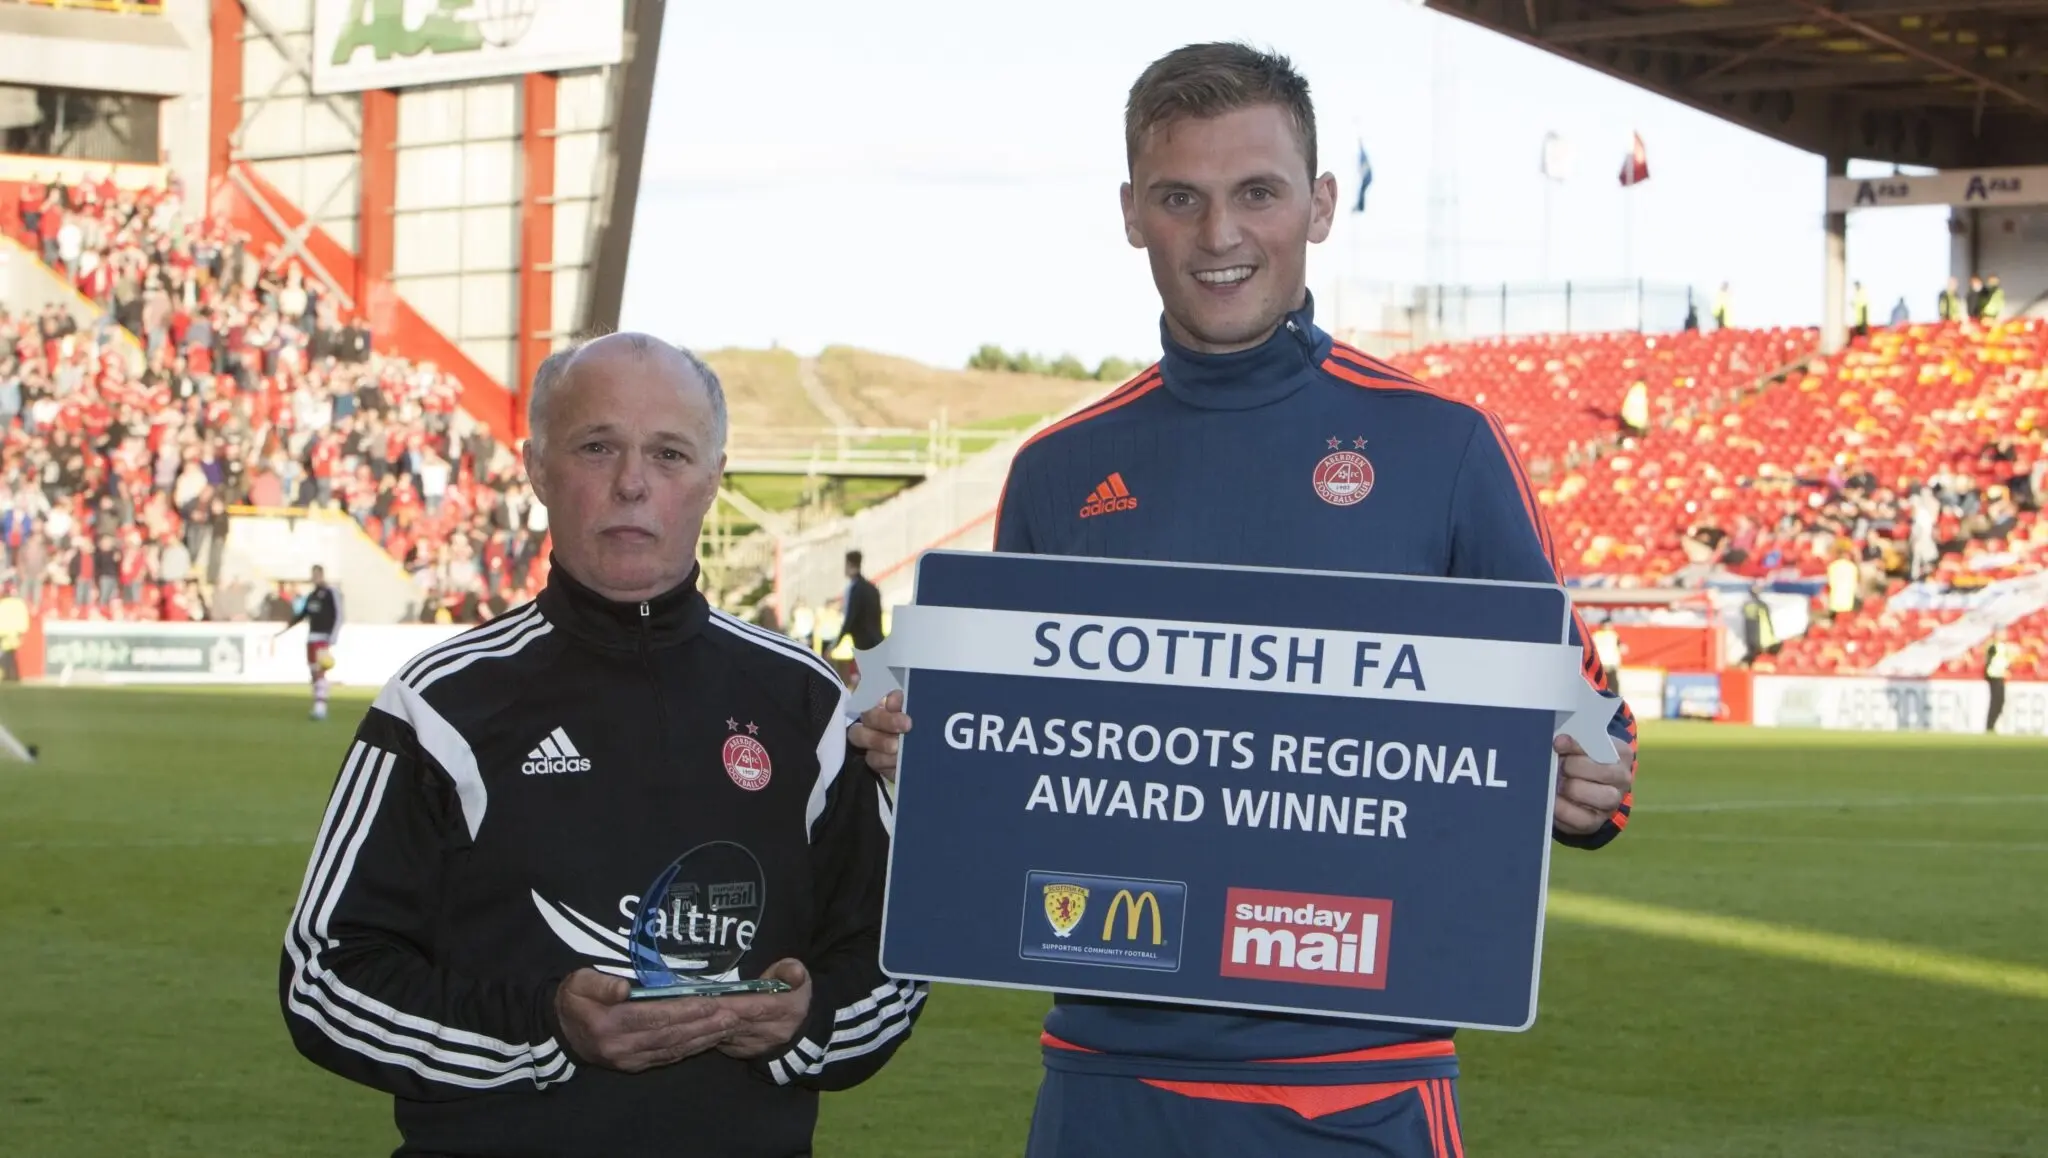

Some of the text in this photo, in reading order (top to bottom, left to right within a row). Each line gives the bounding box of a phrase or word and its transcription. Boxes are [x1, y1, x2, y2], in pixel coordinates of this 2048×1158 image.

[1324, 454, 1366, 468] ABERDEEN
[1316, 481, 1370, 504] FOOTBALL CLUB
[1080, 497, 1137, 518] adidas
[1033, 621, 1427, 692] SCOTTISH FA
[729, 738, 762, 754] ABERDEEN
[944, 712, 1508, 788] GRASSROOTS REGIONAL
[521, 756, 591, 775] adidas
[726, 762, 769, 788] FOOTBALL CLUB
[1025, 774, 1408, 839] AWARD WINNER
[712, 883, 753, 909] mail
[618, 894, 756, 951] Saltire
[1235, 903, 1352, 932] sunday
[1042, 943, 1158, 959] SUPPORTING COMMUNITY FOOTBALL
[1231, 913, 1379, 974] mail
